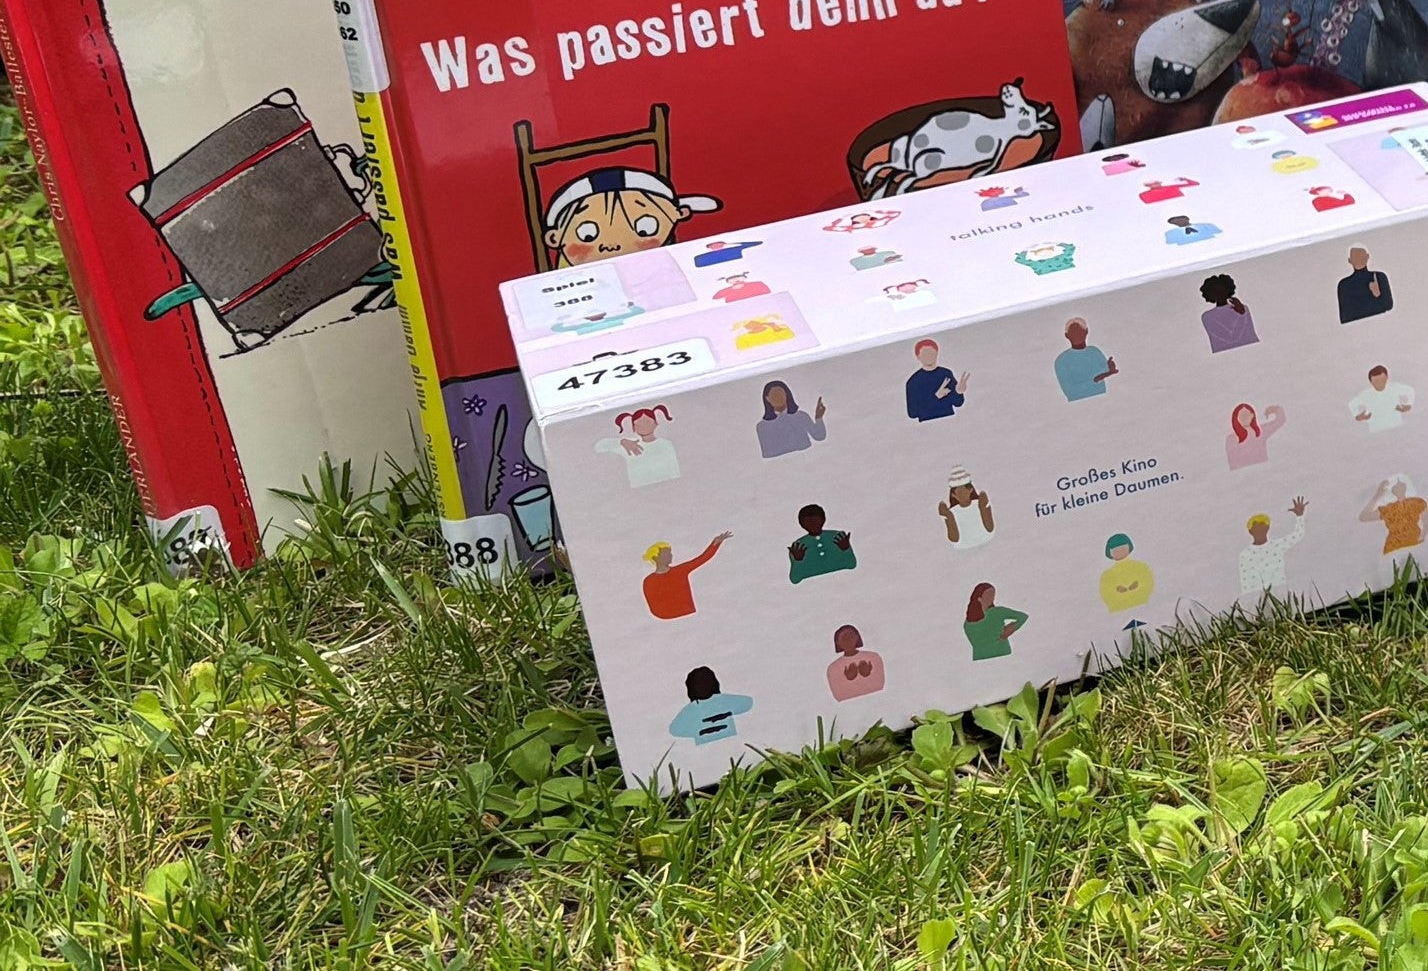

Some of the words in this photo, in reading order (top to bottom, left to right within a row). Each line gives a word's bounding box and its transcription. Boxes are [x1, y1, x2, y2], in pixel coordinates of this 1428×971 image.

[421, 32, 536, 92] Was
[43, 171, 64, 221] Chris
[950, 221, 1023, 241] talking
[1029, 205, 1094, 223] hands
[557, 350, 692, 391] 47383
[1035, 502, 1057, 518] für
[1062, 491, 1109, 511] kleine
[1114, 471, 1185, 497] Daumen.
[1057, 467, 1116, 491] Großes
[1121, 458, 1157, 475] Kino
[448, 537, 498, 569] 88
